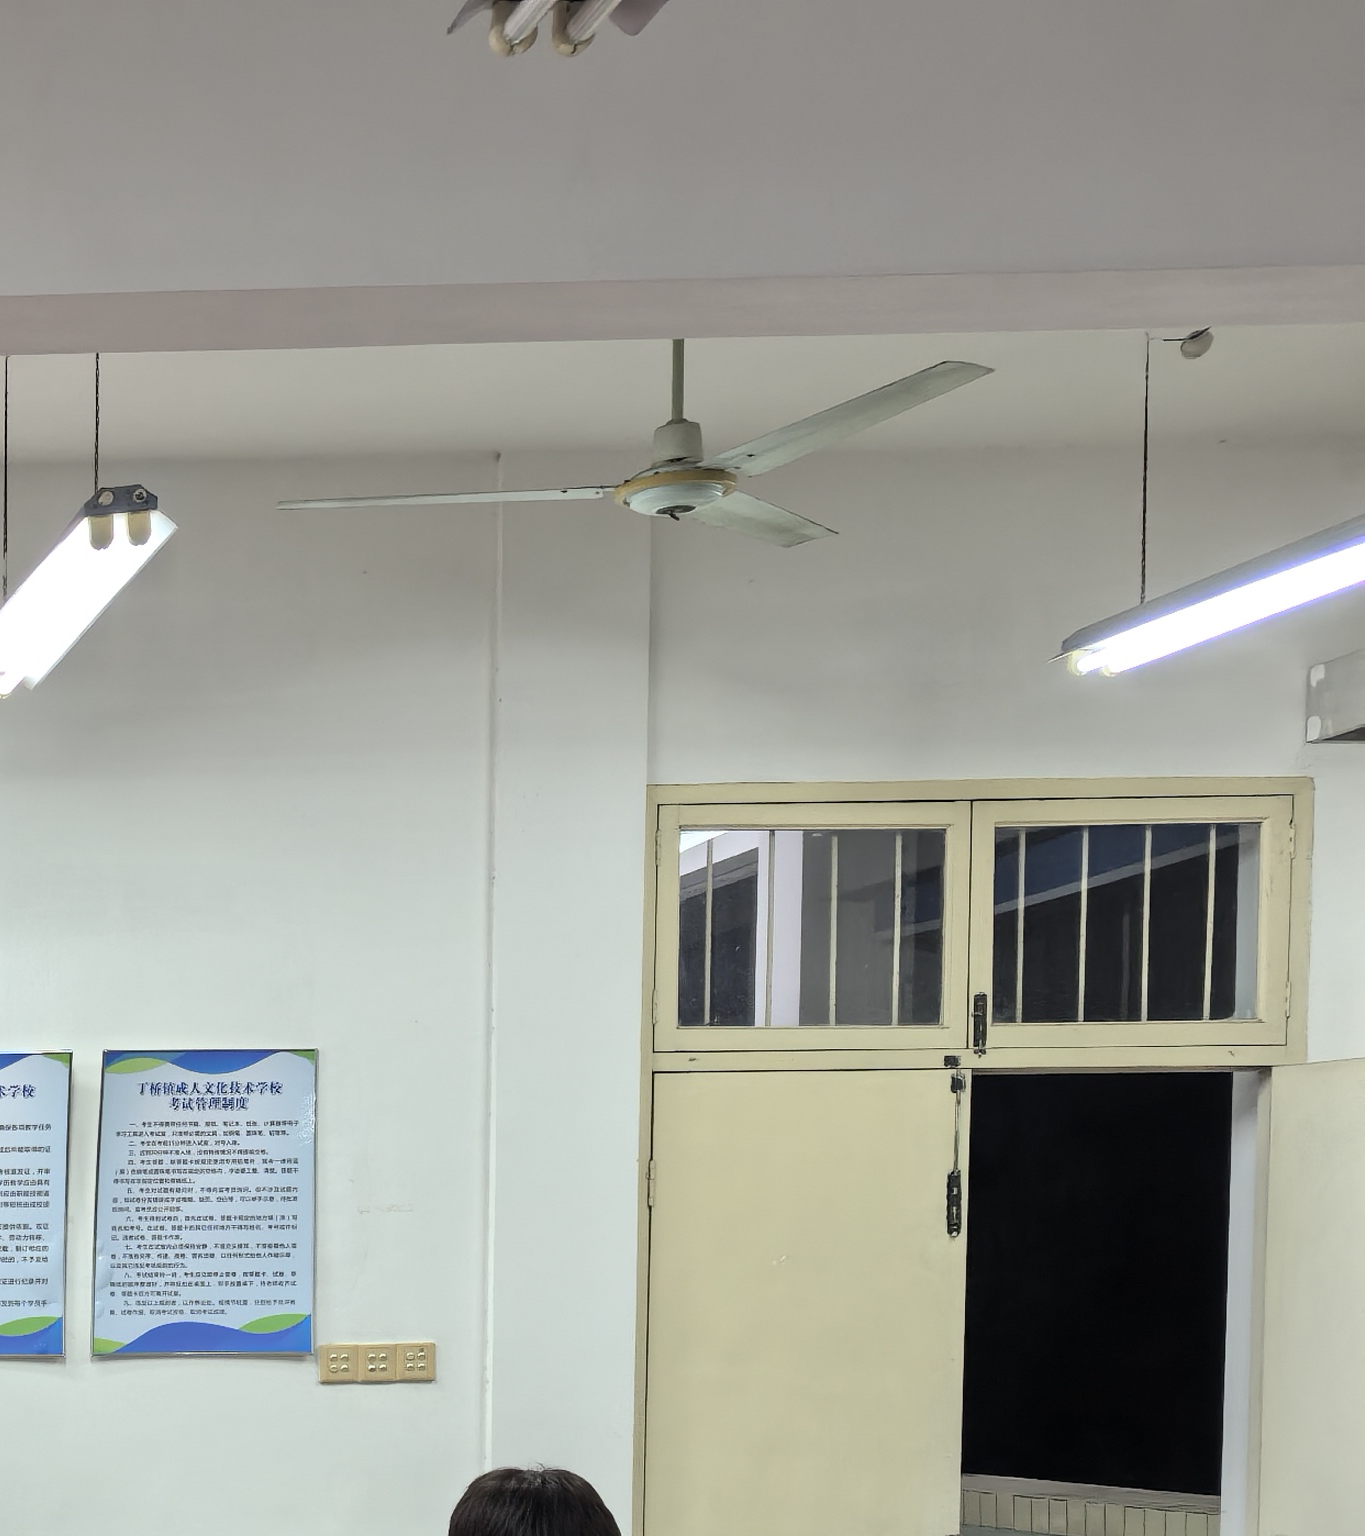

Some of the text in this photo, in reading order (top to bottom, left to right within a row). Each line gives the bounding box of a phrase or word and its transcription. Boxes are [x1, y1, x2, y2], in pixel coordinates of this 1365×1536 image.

[138, 1081, 283, 1096] 丁桥镇成人文化技术学校
[170, 1096, 249, 1111] 考试管理制度
